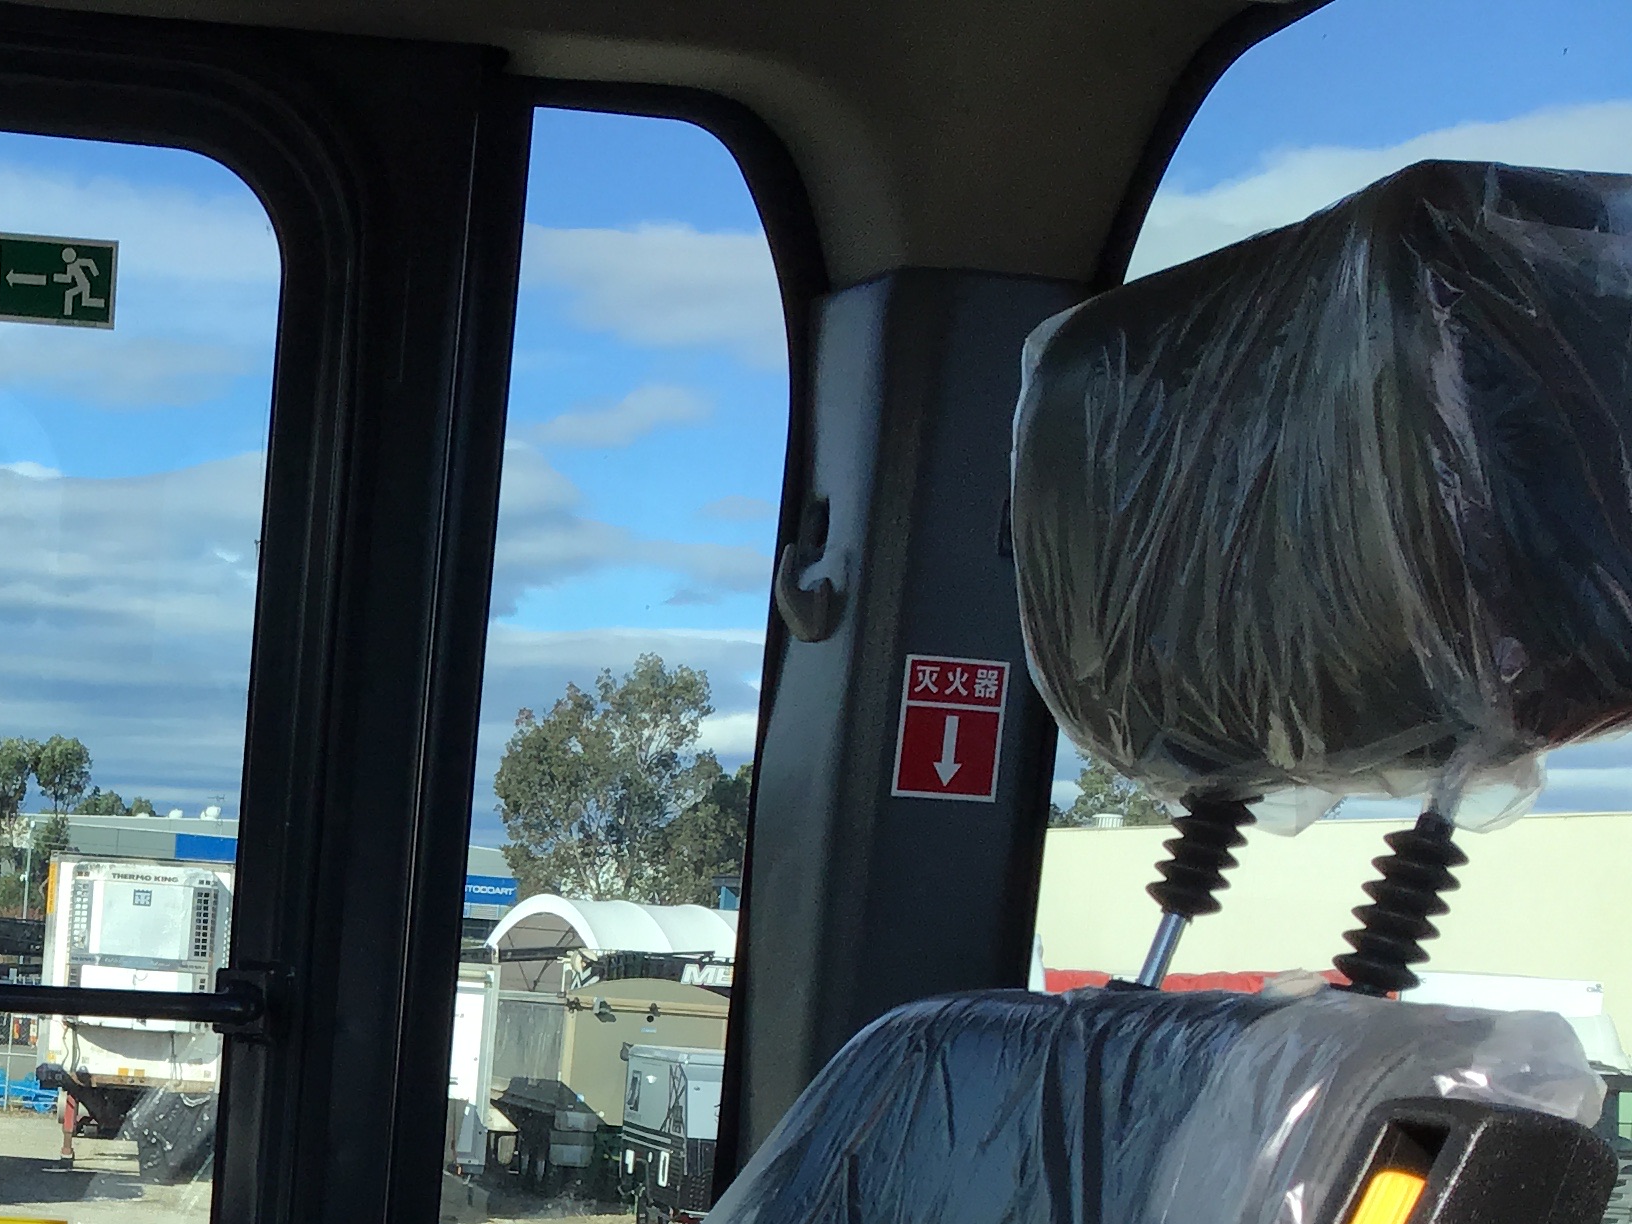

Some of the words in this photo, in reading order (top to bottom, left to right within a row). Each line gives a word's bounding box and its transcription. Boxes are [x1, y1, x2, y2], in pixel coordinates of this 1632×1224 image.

[913, 665, 999, 699] 灭火器
[111, 872, 151, 882] THERMO
[154, 874, 178, 883] KING
